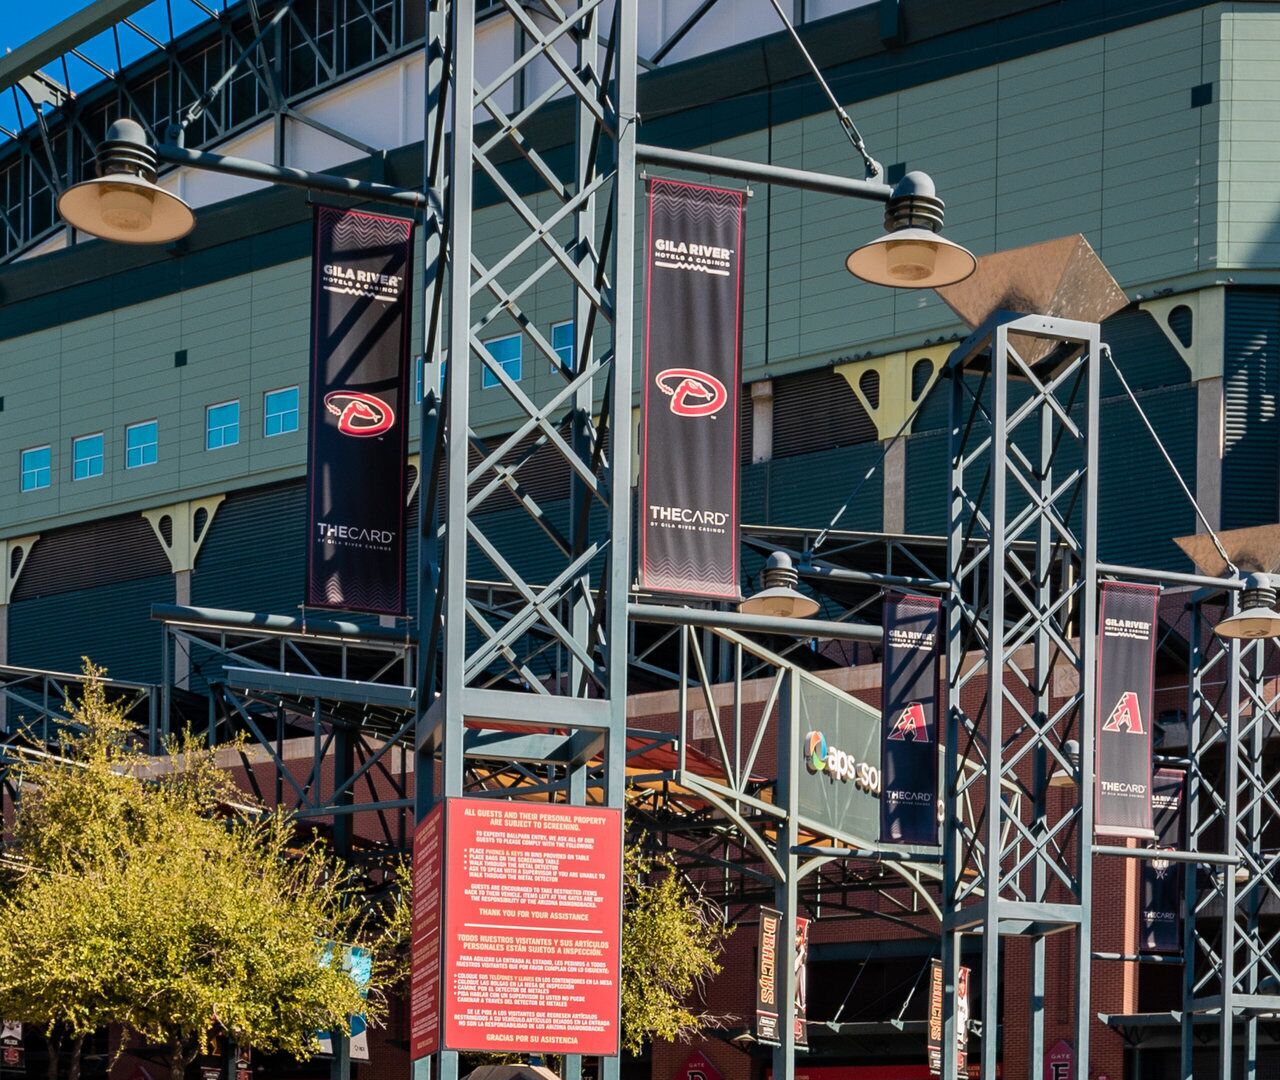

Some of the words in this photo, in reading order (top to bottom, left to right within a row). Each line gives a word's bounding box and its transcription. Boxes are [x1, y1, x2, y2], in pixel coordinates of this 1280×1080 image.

[655, 239, 687, 254] GILA
[689, 243, 730, 260] RIVER
[655, 252, 685, 260] HOTELS
[696, 257, 730, 268] CASINOS
[323, 264, 355, 280] GILA
[356, 270, 398, 287] RIVER
[323, 277, 353, 287] HOTELS
[364, 284, 398, 294] CASINOS
[649, 505, 726, 526] THECARD
[317, 522, 392, 544] THECARD
[698, 526, 725, 534] CASINOS
[1105, 618, 1124, 627] GILA
[1125, 620, 1149, 629] RIVER
[828, 746, 855, 780] aps
[1101, 781, 1145, 793] THECARD
[464, 808, 474, 816] ALL
[477, 809, 502, 818] GUESTS
[504, 810, 517, 819] AND
[519, 811, 537, 820] THEIR
[539, 813, 570, 822] PERSONAL
[573, 815, 605, 825] PROPERTY
[504, 819, 531, 827] SUBJECT
[543, 821, 581, 830] SCREENING.
[479, 907, 500, 915] THANK
[531, 910, 548, 918] YOUR
[550, 912, 588, 920] ASSISTANCE
[457, 933, 478, 941] TODOS
[479, 934, 513, 943] NUESTROS
[515, 936, 551, 945] VISITANTES
[574, 938, 609, 948] ARTÍCULOS
[463, 941, 504, 950] PERSONALES
[505, 942, 526, 952] ESTÁN
[528, 945, 555, 953] SUJETOS
[563, 945, 603, 956] INSPECCIÓN.
[485, 1033, 513, 1041] GRACIAS
[515, 1034, 528, 1042] POR
[540, 1036, 578, 1044] ASISTENCIA
